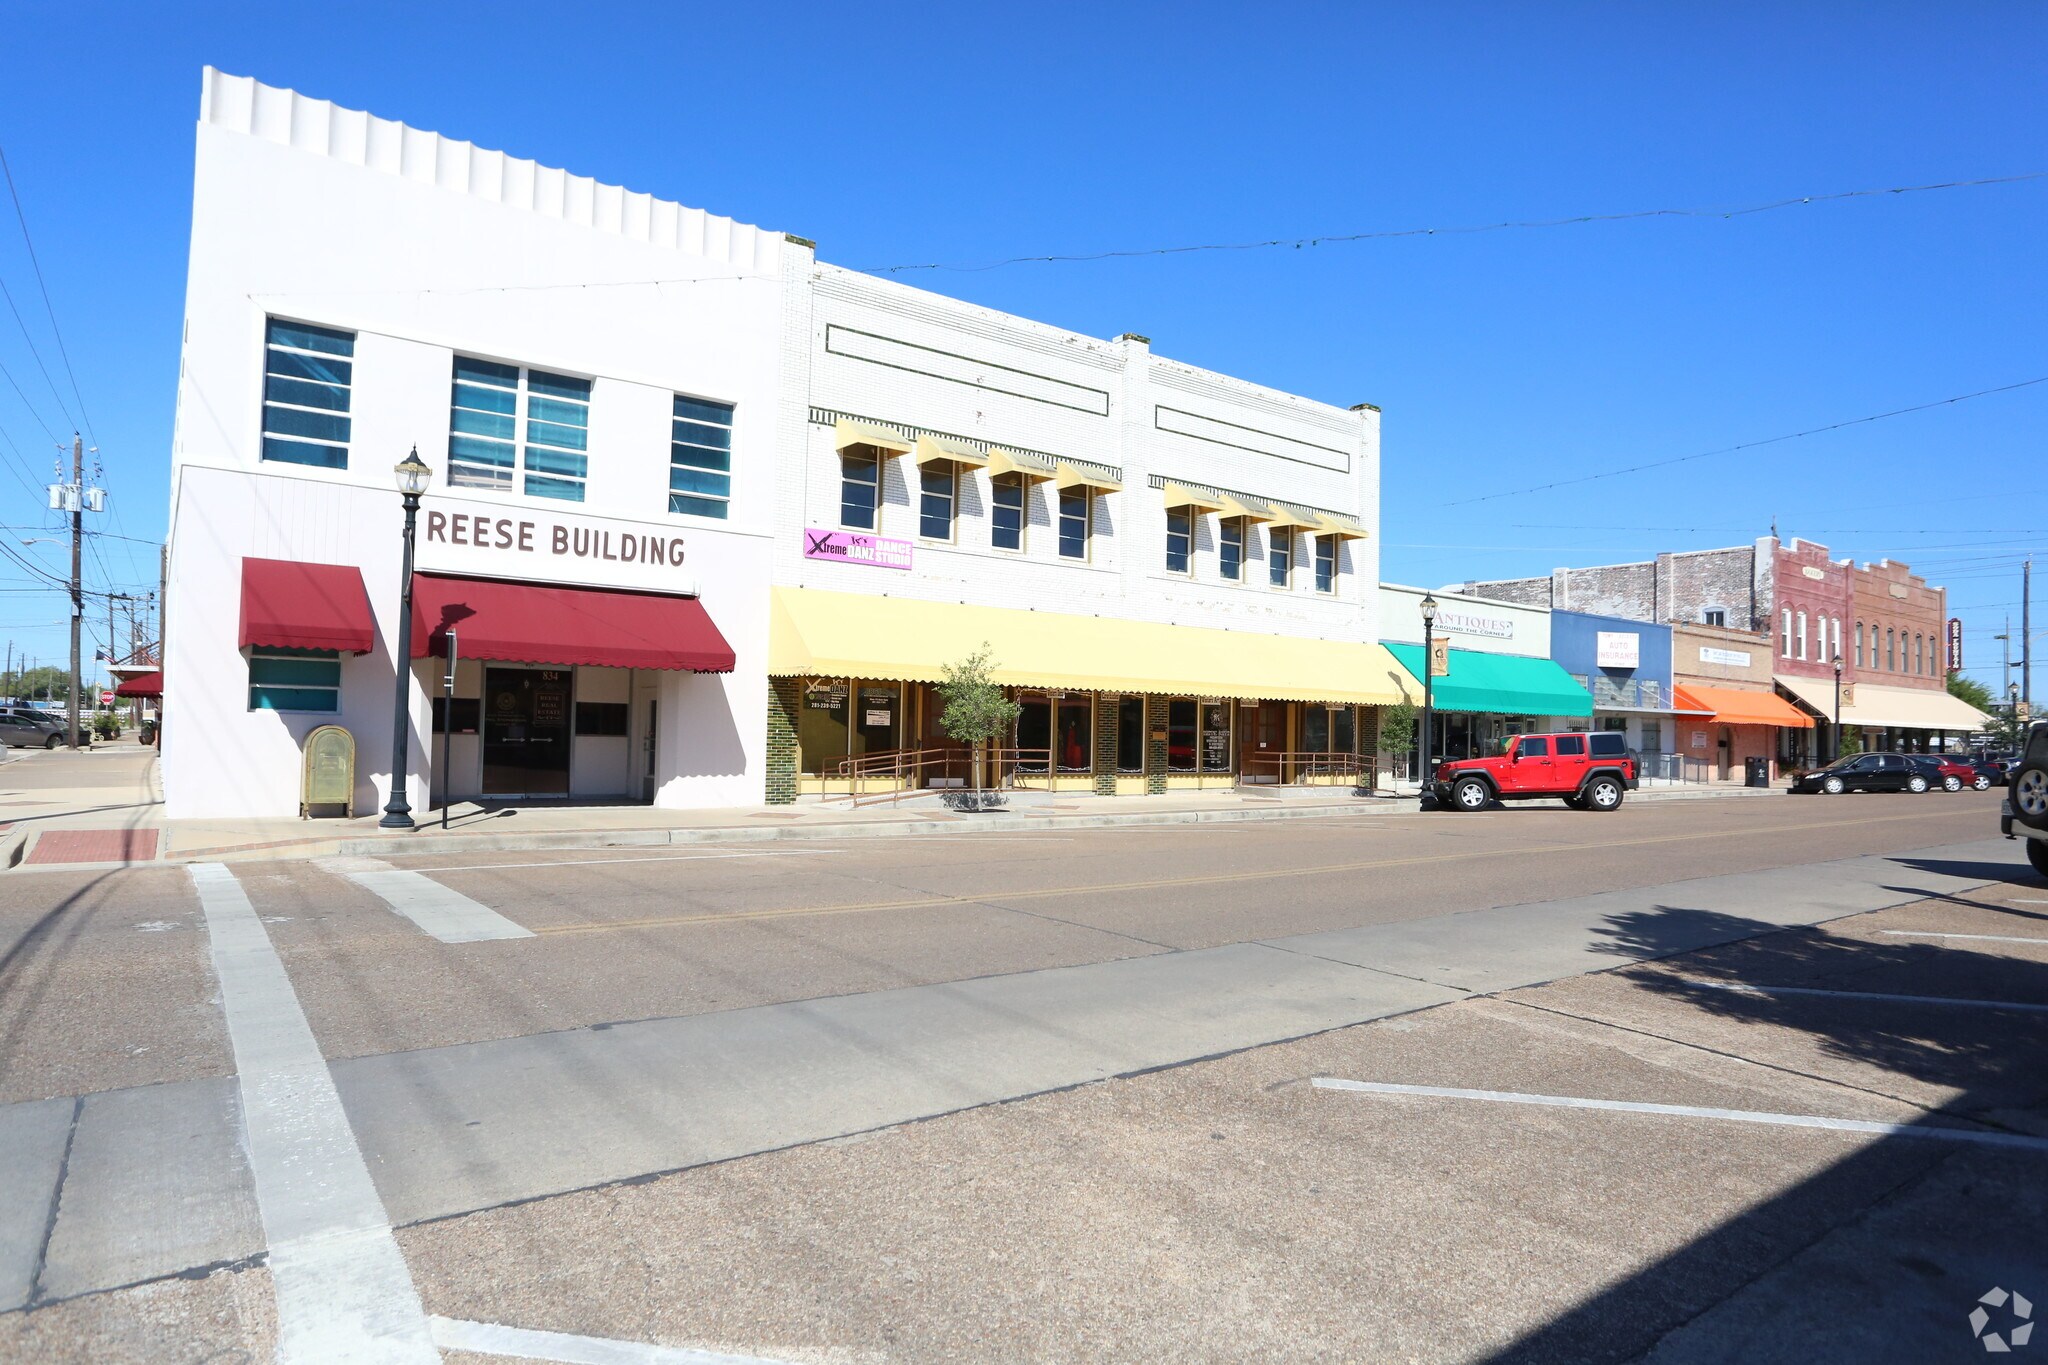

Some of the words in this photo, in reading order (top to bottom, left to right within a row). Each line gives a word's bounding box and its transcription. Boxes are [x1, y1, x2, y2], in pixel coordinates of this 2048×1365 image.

[427, 510, 536, 552] REESE
[552, 524, 686, 568] BUILDING
[806, 532, 847, 556] Xtreme
[847, 544, 875, 561] DANZ
[875, 539, 912, 556] DANCE
[875, 550, 912, 566] STUDIO
[1433, 611, 1506, 632] ANTIQUES
[1434, 624, 1464, 632] AROUND
[1609, 641, 1629, 650] AUTO
[1598, 651, 1638, 661] INSURANCE
[542, 671, 559, 681] 834
